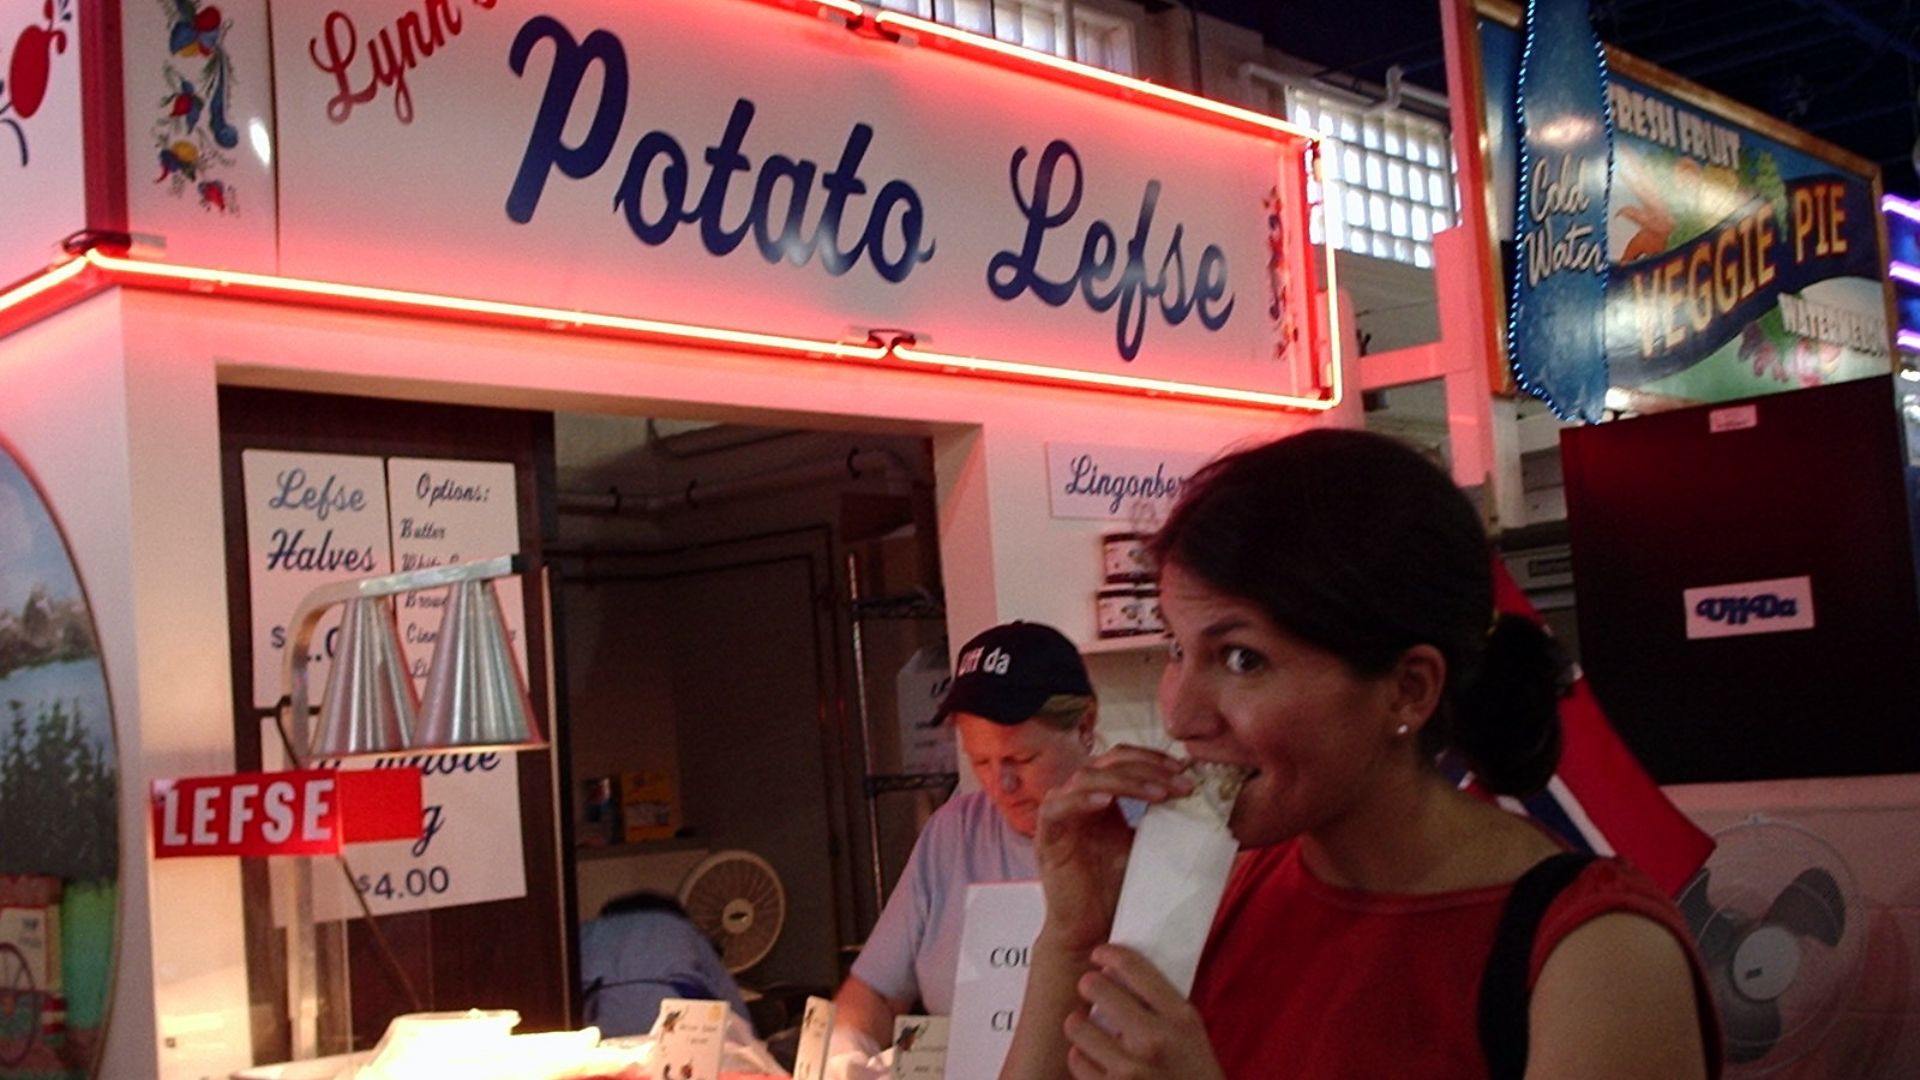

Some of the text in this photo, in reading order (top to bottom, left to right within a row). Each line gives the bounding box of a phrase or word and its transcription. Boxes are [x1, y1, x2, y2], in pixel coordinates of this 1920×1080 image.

[309, 0, 496, 124] Lynn
[1677, 110, 1740, 170] FRUIT
[505, 15, 1235, 362] Potato Lefse
[1530, 154, 1590, 222] Cold
[1523, 218, 1608, 287] Water
[1633, 184, 1848, 359] VEGGIE PIE
[268, 468, 367, 521] Lefse
[416, 472, 491, 508] Options:
[266, 528, 375, 571] Halves
[400, 517, 446, 538] Butter
[983, 646, 1011, 675] da
[162, 779, 335, 847] LEFSE
[357, 866, 449, 899] $4.00
